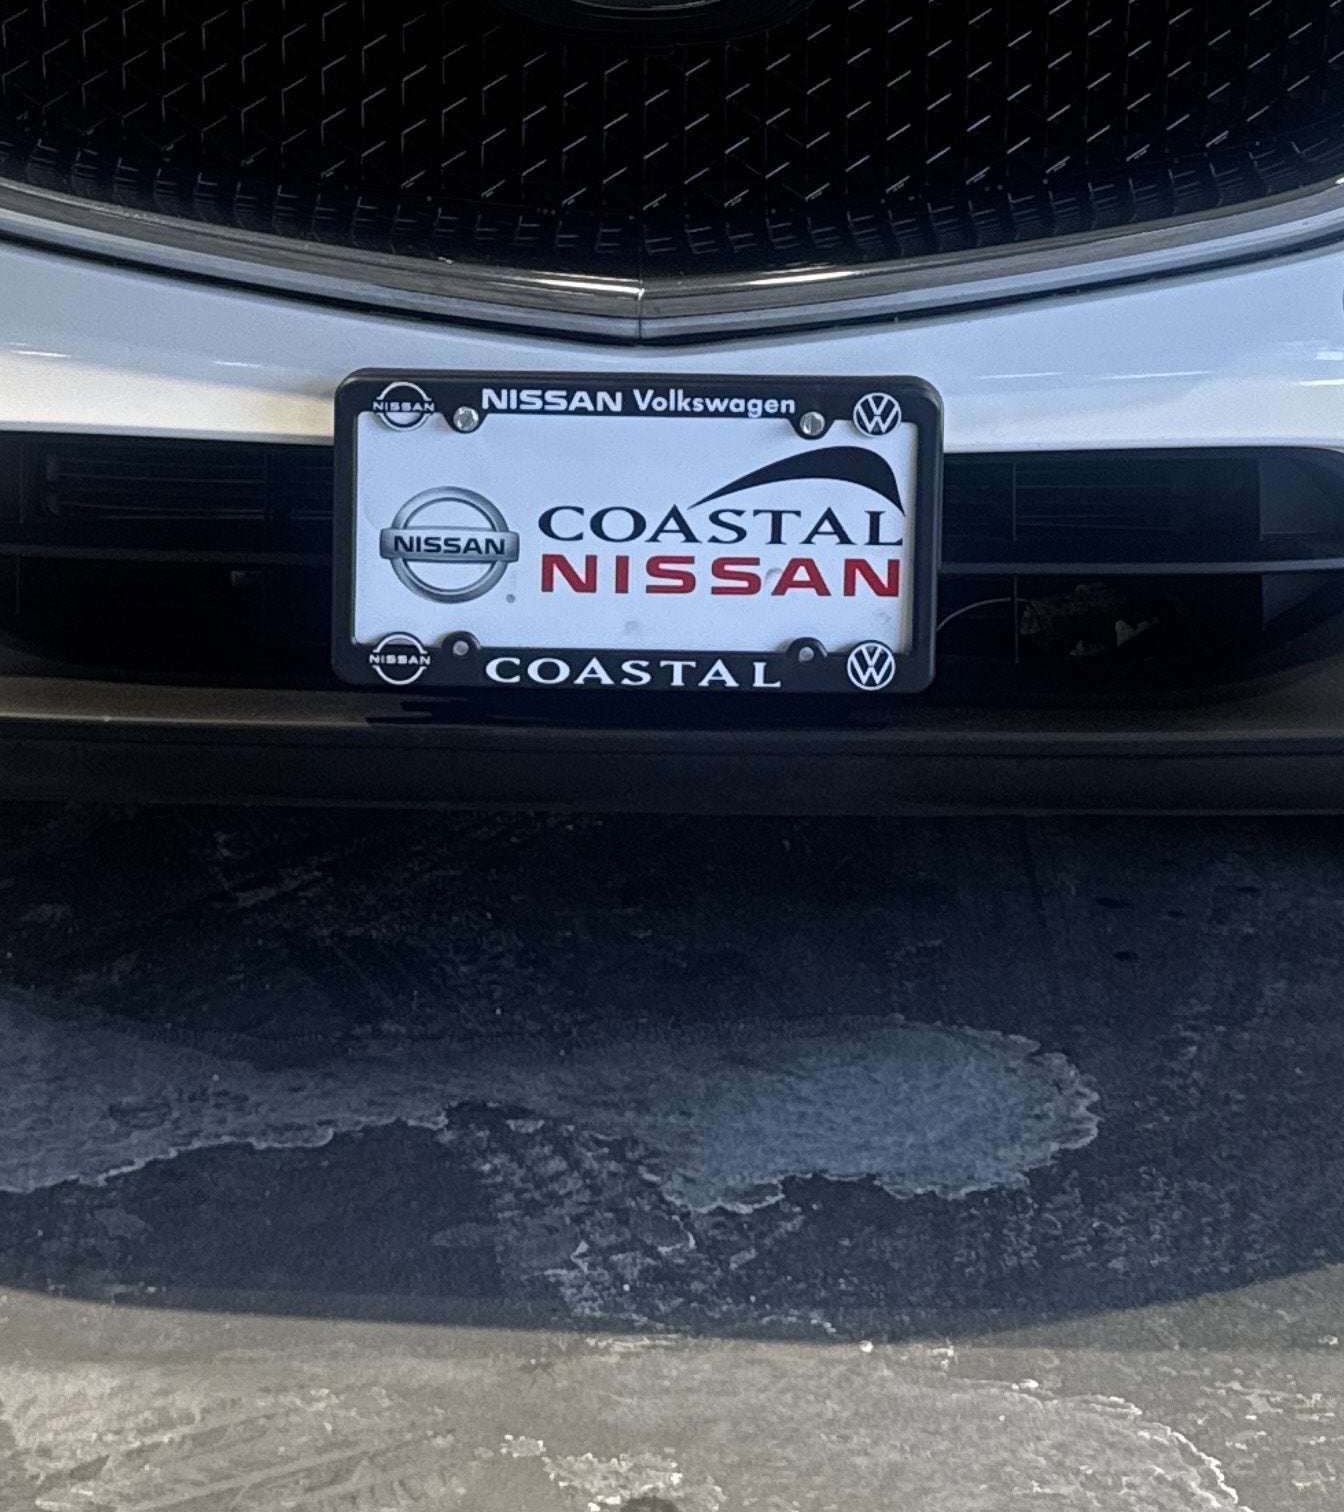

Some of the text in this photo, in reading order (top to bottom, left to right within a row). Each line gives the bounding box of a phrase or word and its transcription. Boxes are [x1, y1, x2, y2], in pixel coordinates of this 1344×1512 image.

[372, 400, 435, 412] NISSAN
[481, 389, 796, 418] NISSAN Volkswagen
[538, 504, 904, 546] COASTAL
[393, 534, 506, 556] NISSAN
[539, 553, 900, 597] NISSAN
[369, 654, 431, 666] NISSAN
[485, 656, 782, 688] COASTAL
